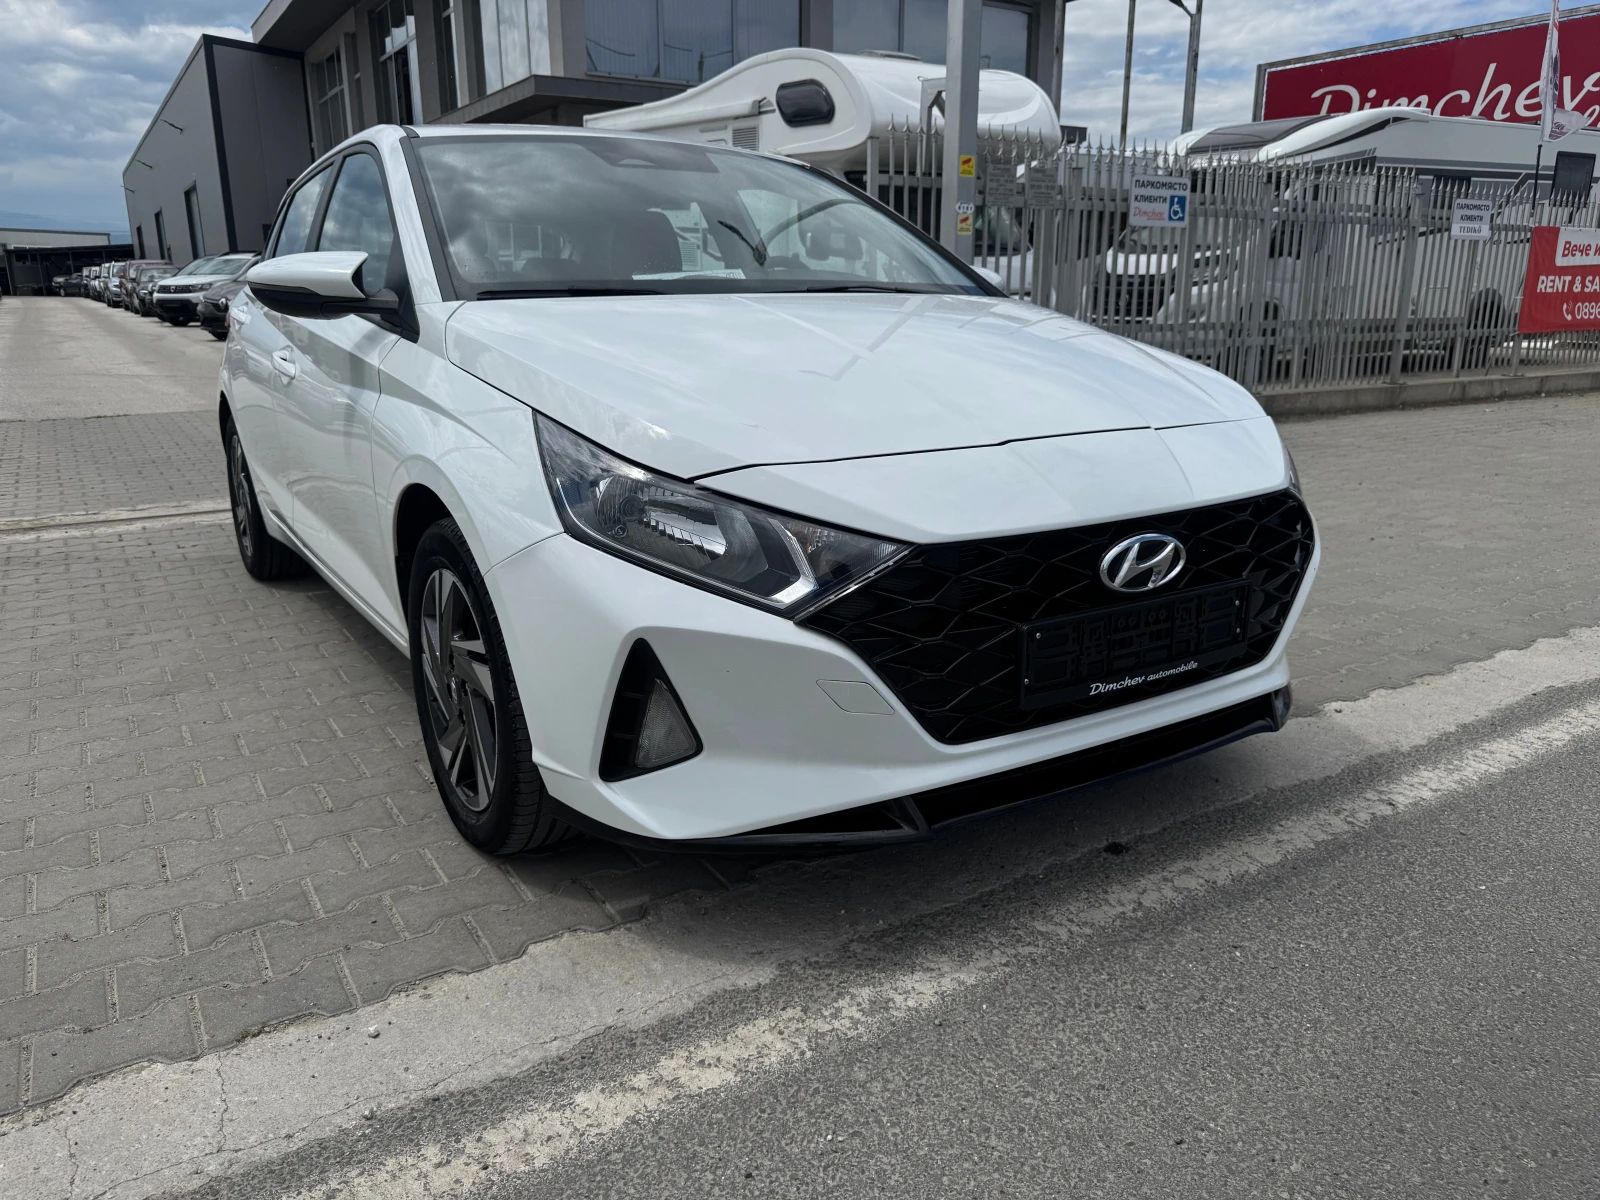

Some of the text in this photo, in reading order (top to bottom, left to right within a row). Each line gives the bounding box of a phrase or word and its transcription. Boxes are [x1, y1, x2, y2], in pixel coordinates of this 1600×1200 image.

[1134, 179, 1188, 191] ПАРКОМЯСТО
[1134, 194, 1167, 204] КЛИЕНТИ
[1456, 203, 1490, 211] ПАРКОМЯСТО
[1460, 214, 1484, 222] КЛИЕНТИ
[1561, 241, 1591, 258] Вече
[1536, 275, 1600, 292] RENT & SA
[1089, 660, 1198, 696] Dimchev automobile
